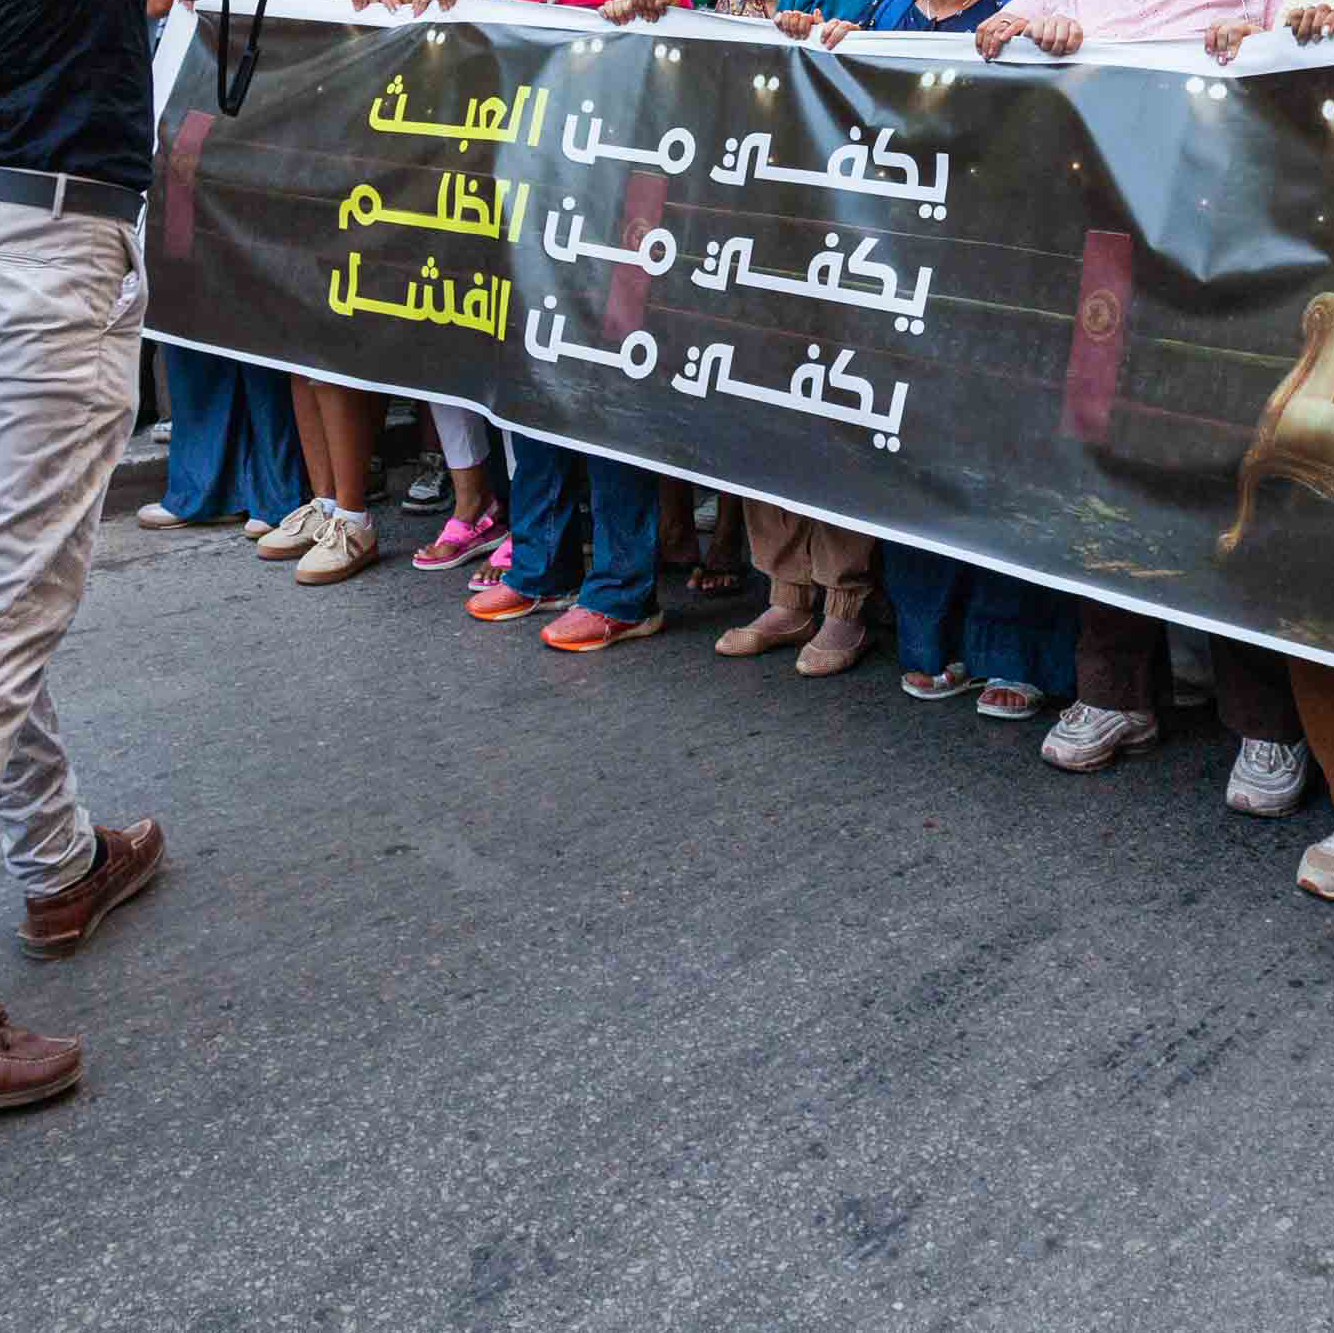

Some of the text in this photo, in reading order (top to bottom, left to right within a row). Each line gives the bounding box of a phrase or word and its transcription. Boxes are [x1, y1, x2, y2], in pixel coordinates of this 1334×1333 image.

[368, 74, 949, 222] يكفي من العبث
[337, 171, 933, 336] يكفي من الظلم
[327, 251, 910, 454] يكفي من الفشل
